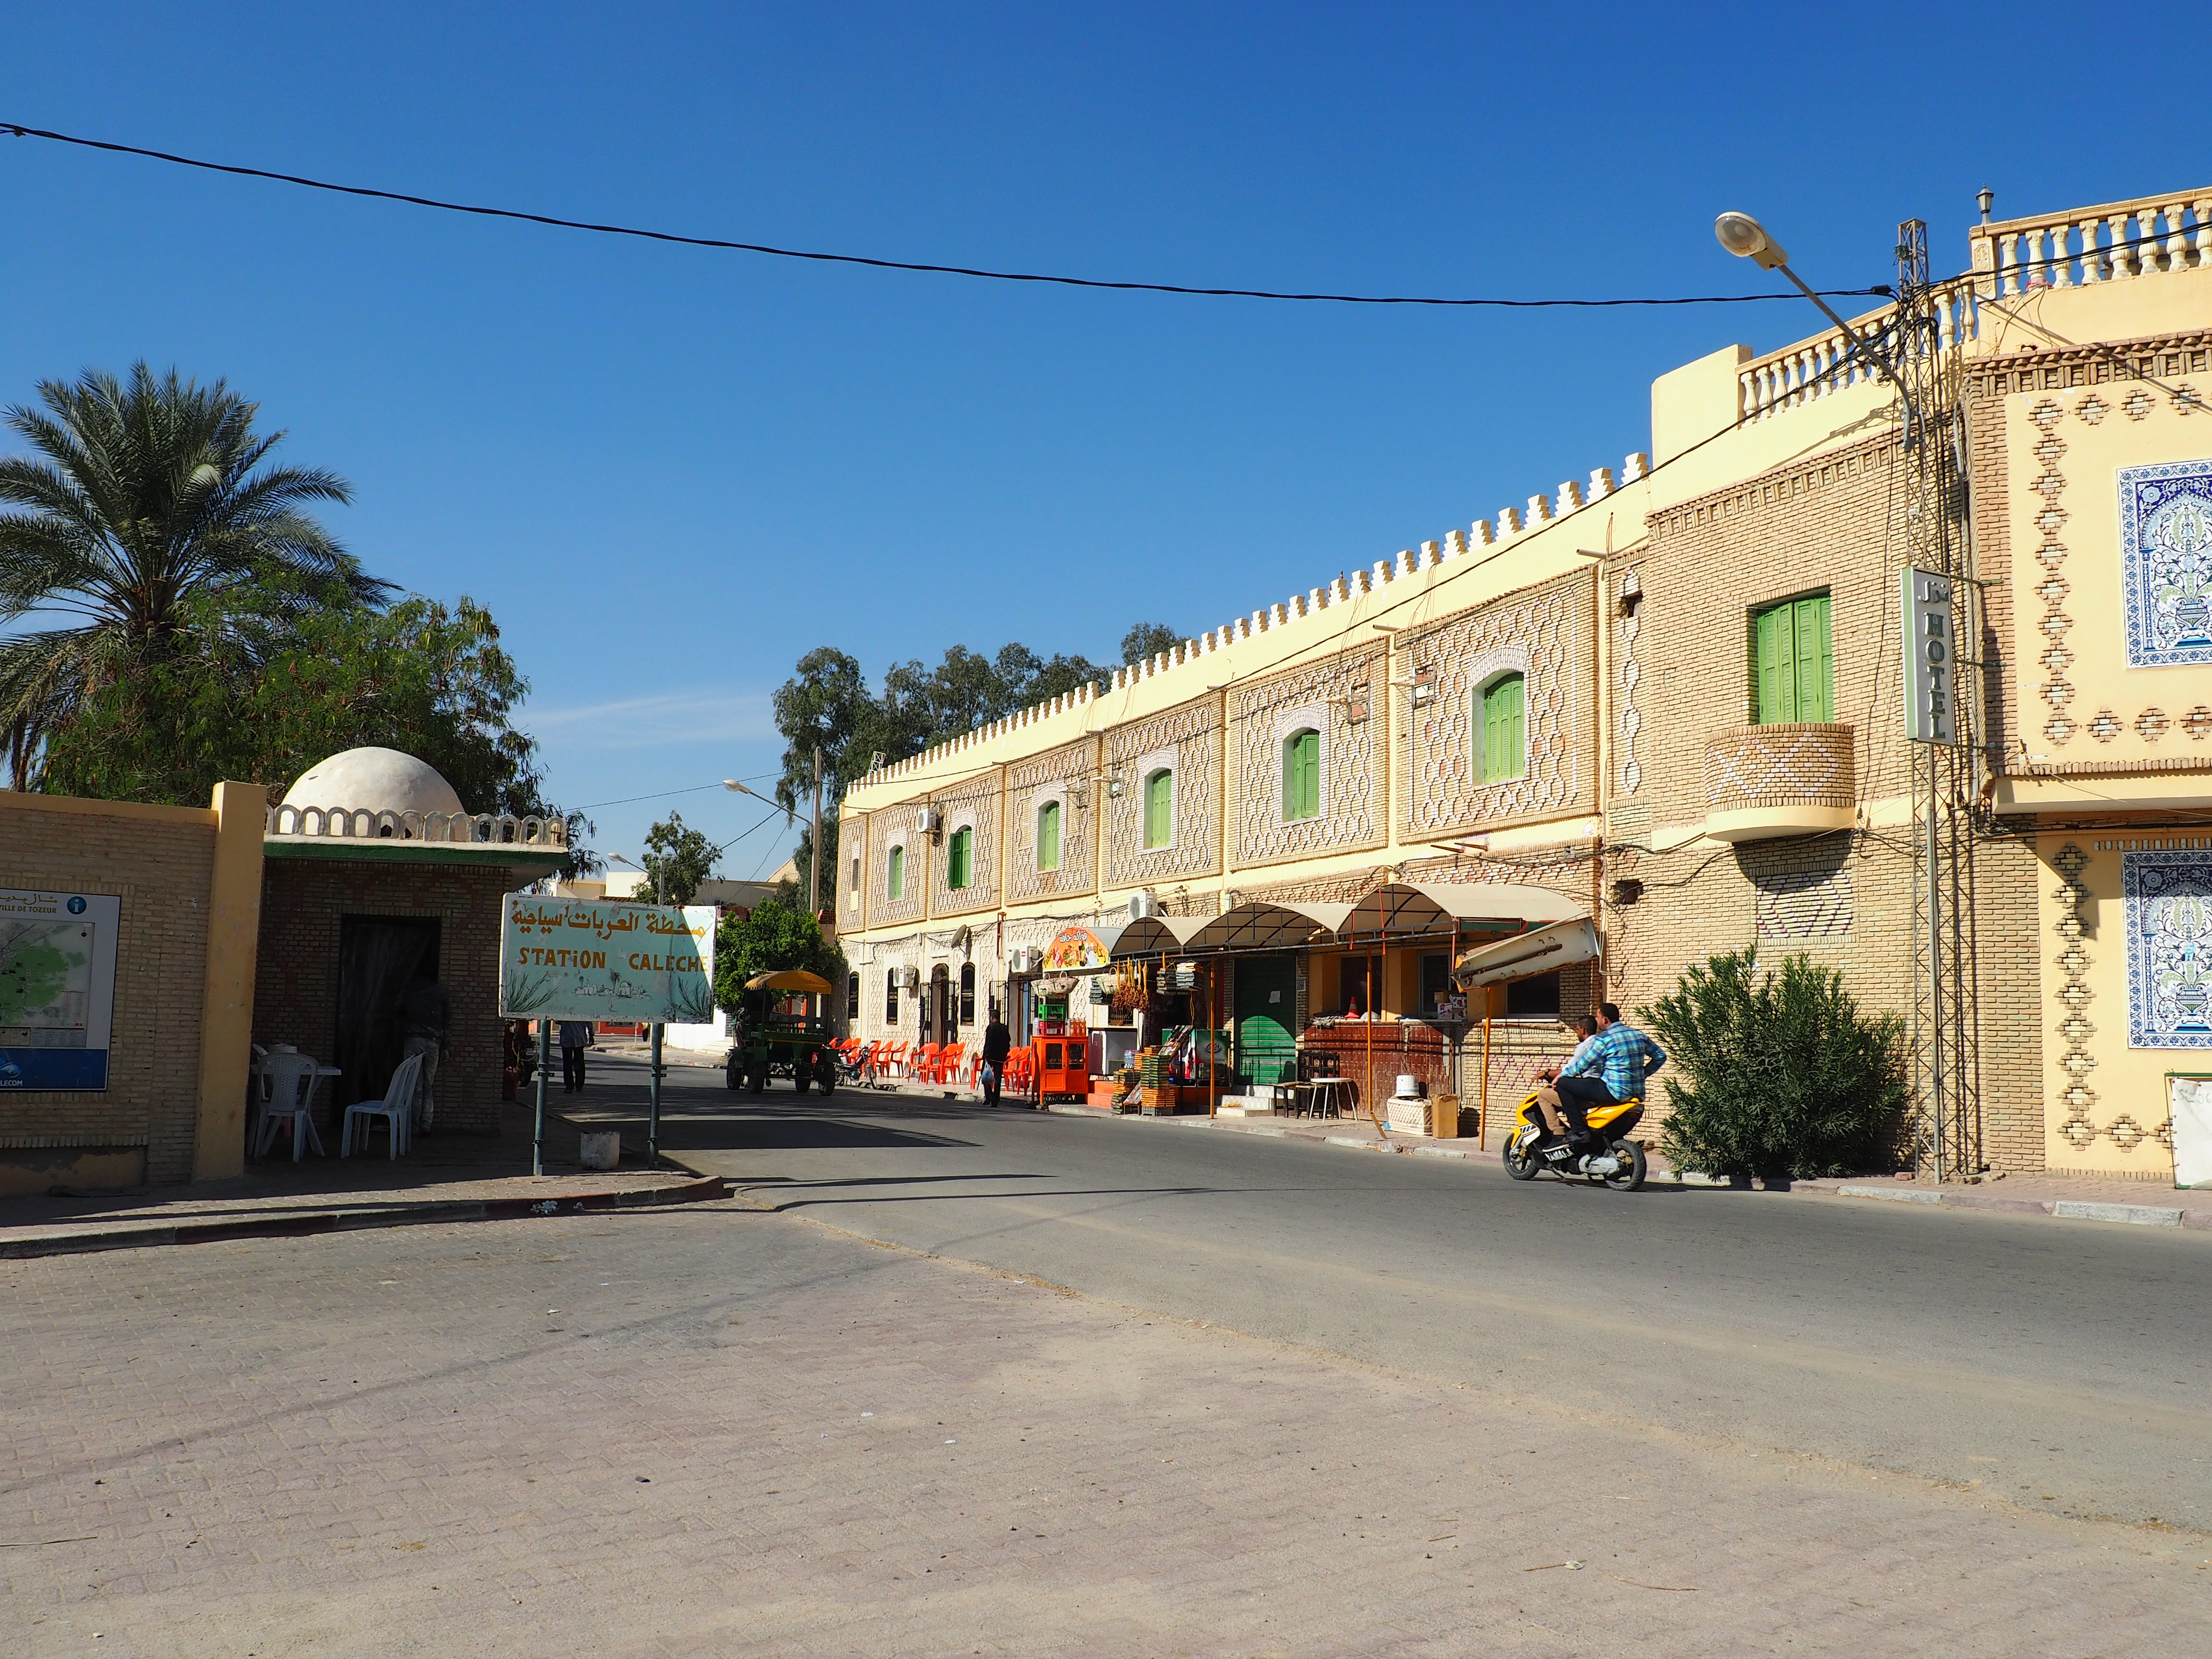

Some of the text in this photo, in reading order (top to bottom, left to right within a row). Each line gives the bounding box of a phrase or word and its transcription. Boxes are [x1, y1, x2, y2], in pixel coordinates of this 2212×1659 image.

[1923, 611, 1945, 739] HOTEL
[568, 909, 640, 940] العربات
[645, 913, 706, 938] محطة
[629, 953, 709, 973] CALECHE
